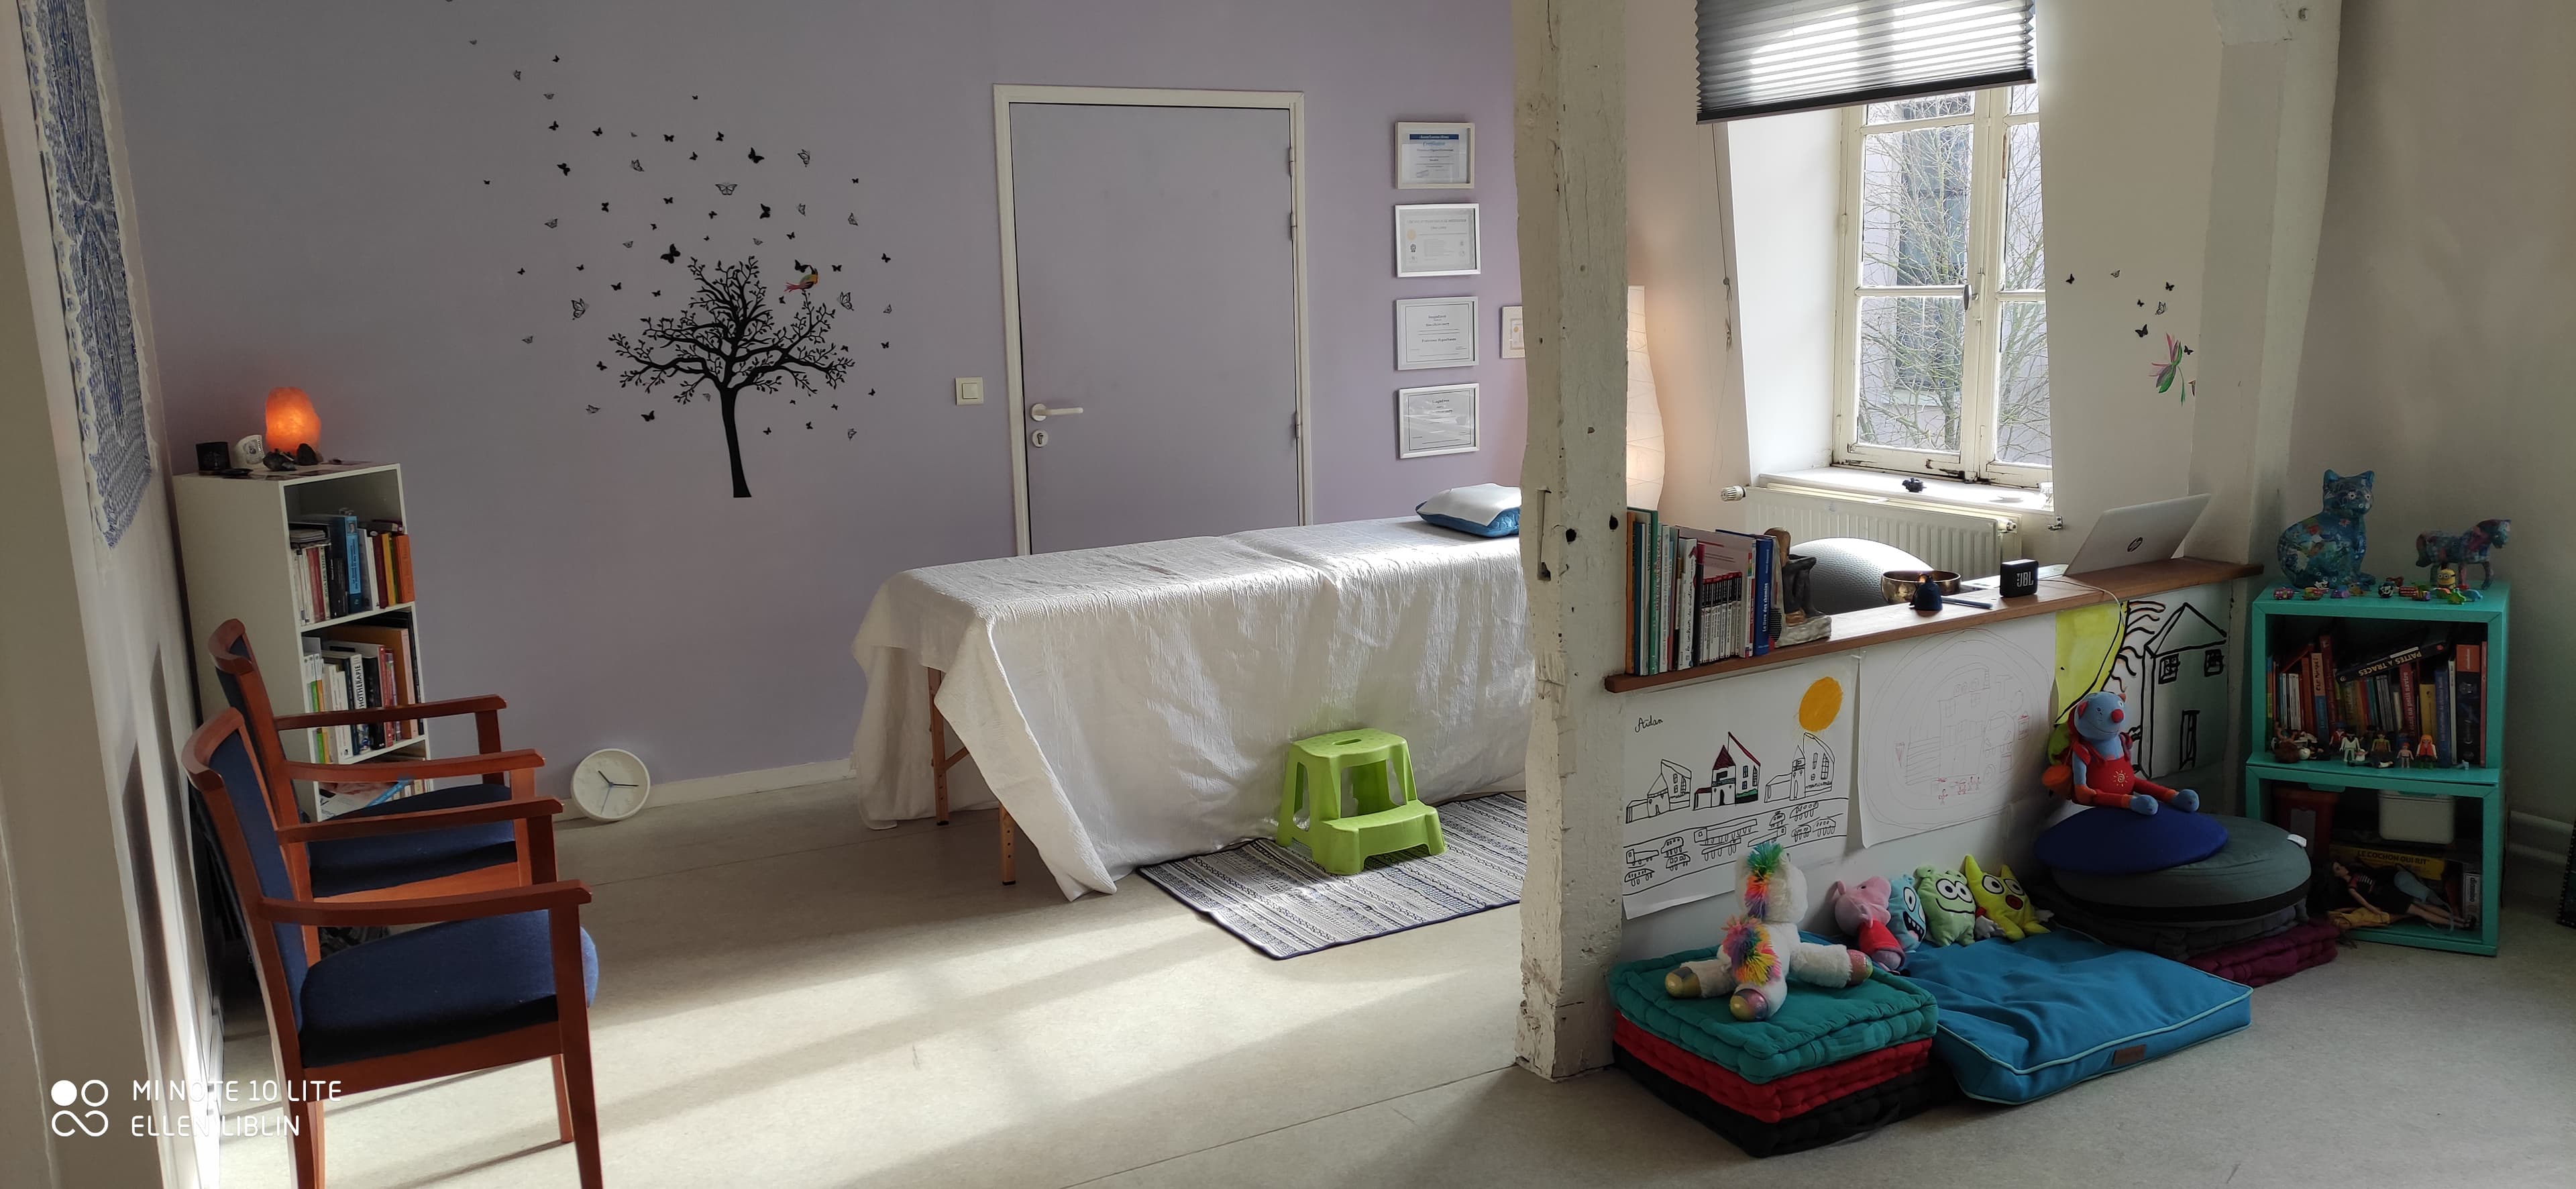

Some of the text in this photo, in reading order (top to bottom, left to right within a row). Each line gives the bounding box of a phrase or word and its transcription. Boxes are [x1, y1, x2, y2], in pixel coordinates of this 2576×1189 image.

[2017, 571, 2034, 587] JBL
[2395, 651, 2422, 664] PATTES
[2358, 662, 2388, 676] TRACES
[355, 664, 365, 710] HOTHERAPIE
[2404, 692, 2412, 707] petit
[2367, 852, 2399, 862] COCHON
[2400, 856, 2414, 864] QUI
